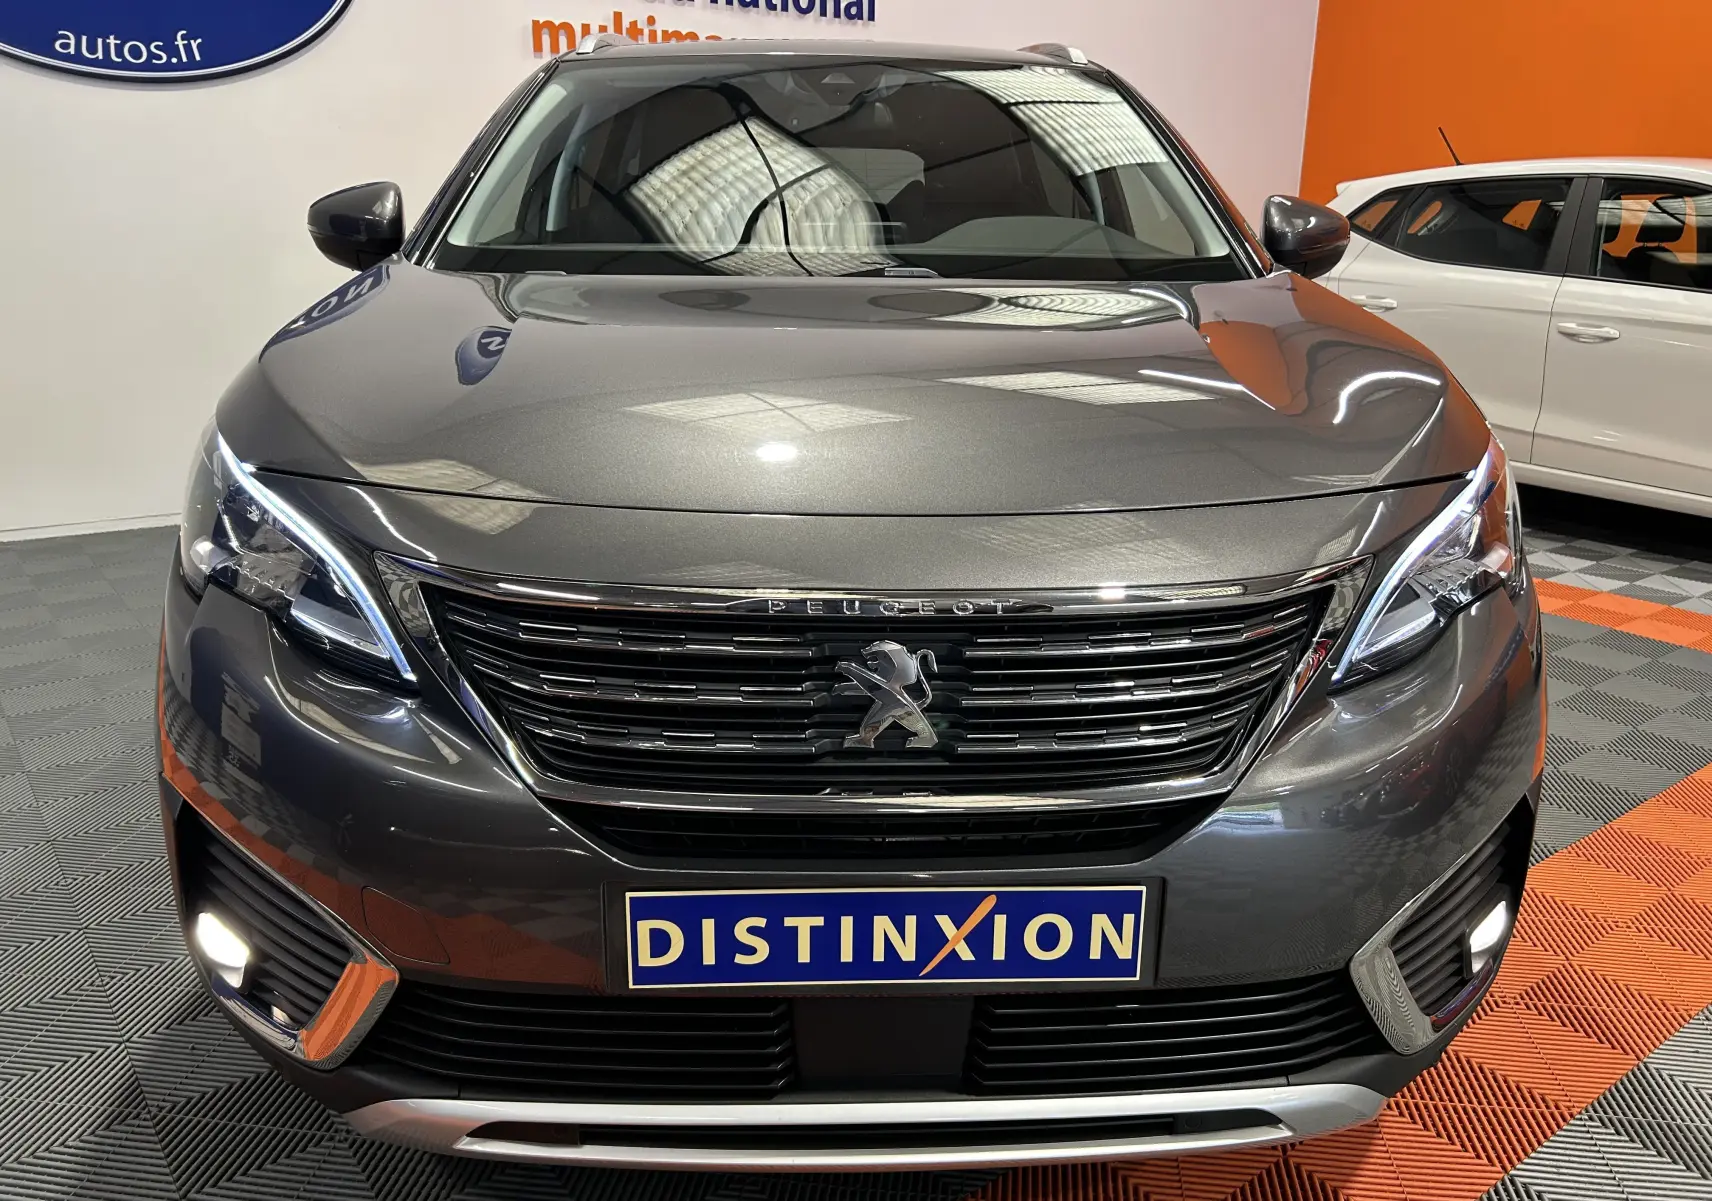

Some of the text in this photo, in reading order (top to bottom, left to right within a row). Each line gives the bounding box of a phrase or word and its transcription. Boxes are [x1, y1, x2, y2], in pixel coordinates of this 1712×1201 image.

[54, 30, 203, 64] autos.fr
[767, 598, 1016, 615] PEUGEOT
[636, 894, 1135, 977] DISTINXION
